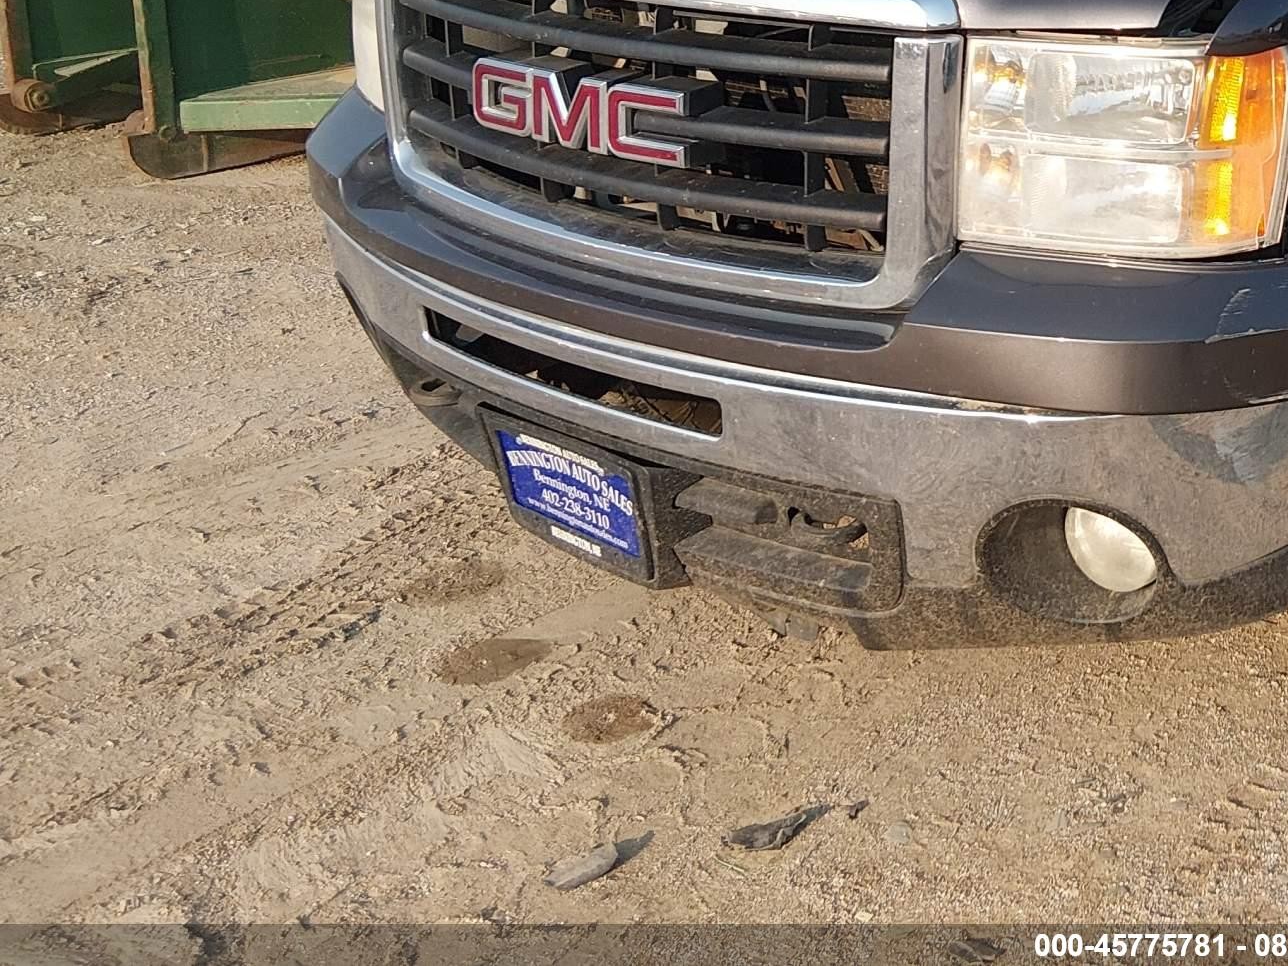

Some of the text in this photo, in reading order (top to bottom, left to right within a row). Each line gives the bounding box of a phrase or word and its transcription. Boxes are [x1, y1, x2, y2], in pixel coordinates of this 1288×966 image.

[473, 57, 686, 168] GMC
[506, 451, 633, 516] BENNINGTON AUTO SALES
[533, 468, 611, 512] Bennington, NE
[541, 488, 610, 529] 402-238-3110
